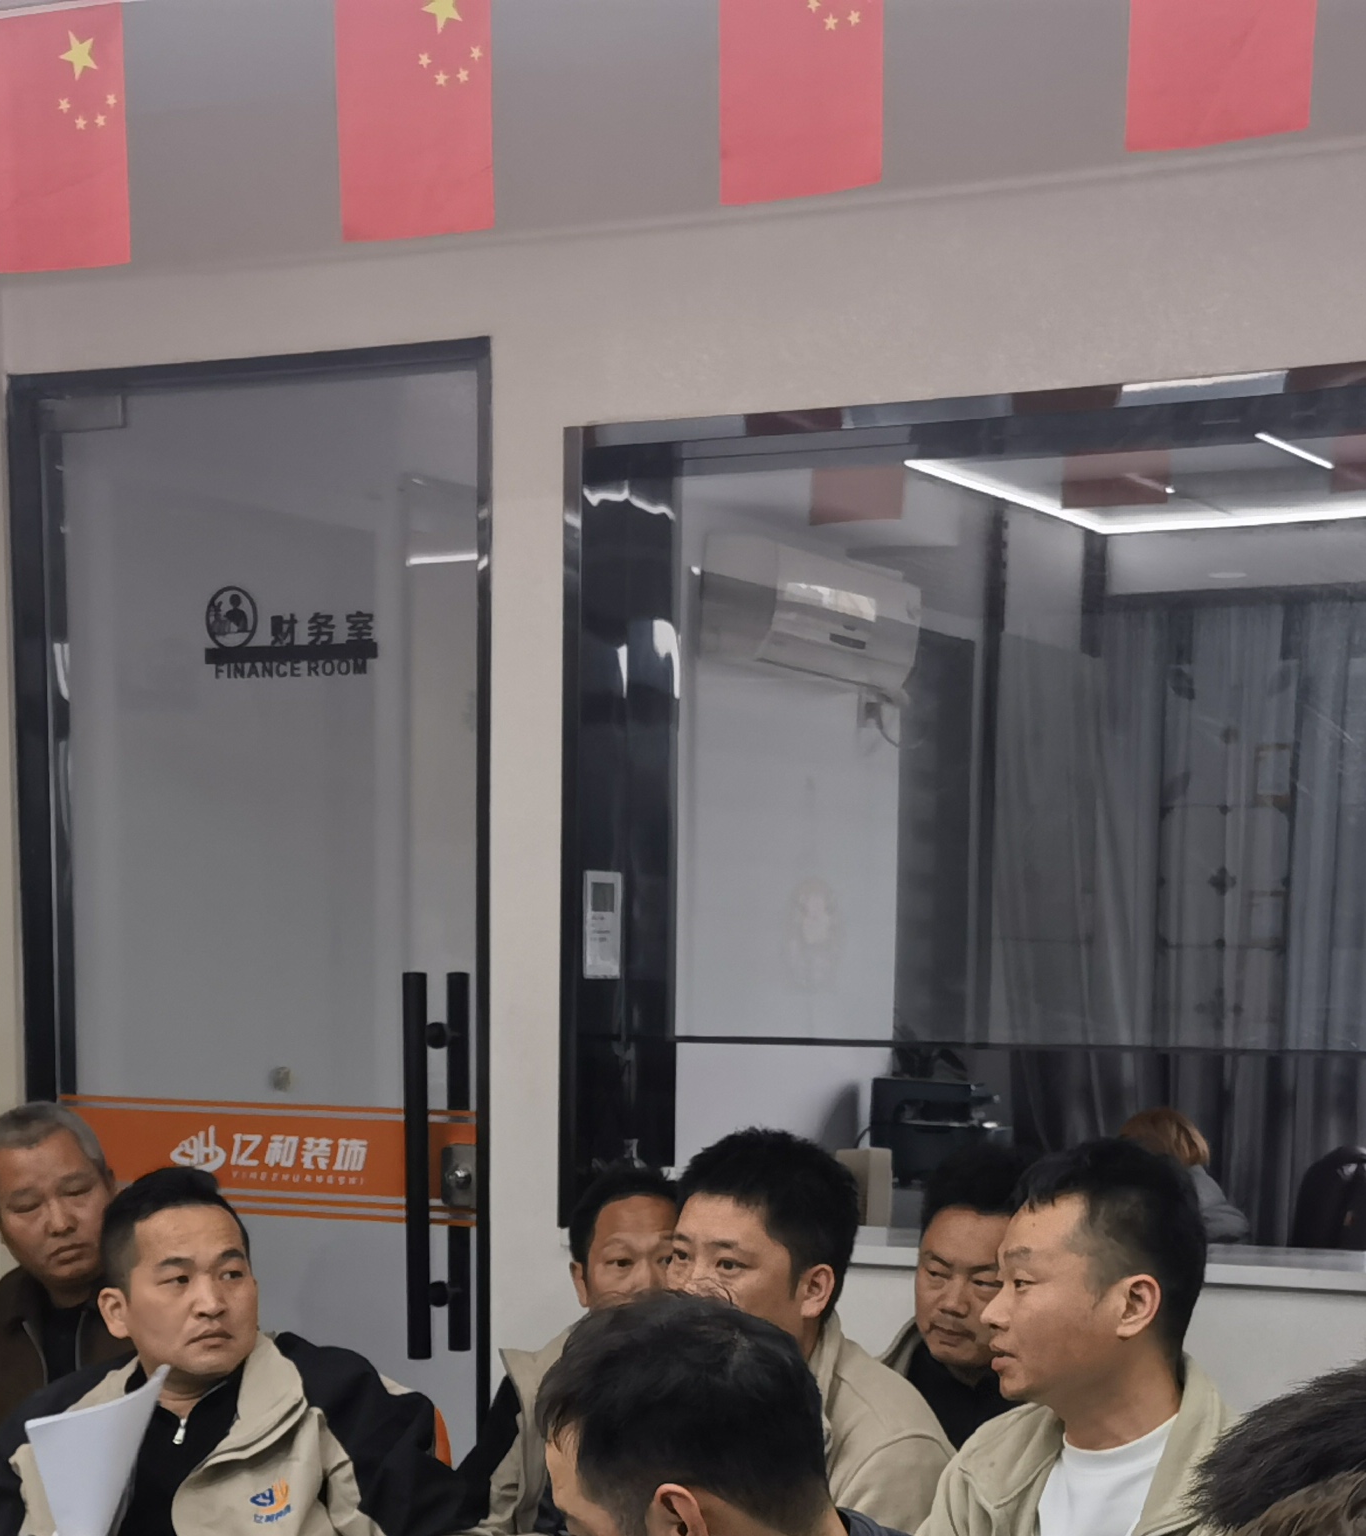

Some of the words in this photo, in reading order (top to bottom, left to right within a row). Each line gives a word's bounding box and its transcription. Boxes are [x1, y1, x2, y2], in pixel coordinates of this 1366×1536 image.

[271, 611, 374, 646] 财务室
[215, 661, 301, 680] FINANCE
[307, 658, 367, 676] ROOM
[230, 1133, 368, 1171] 亿和装饰
